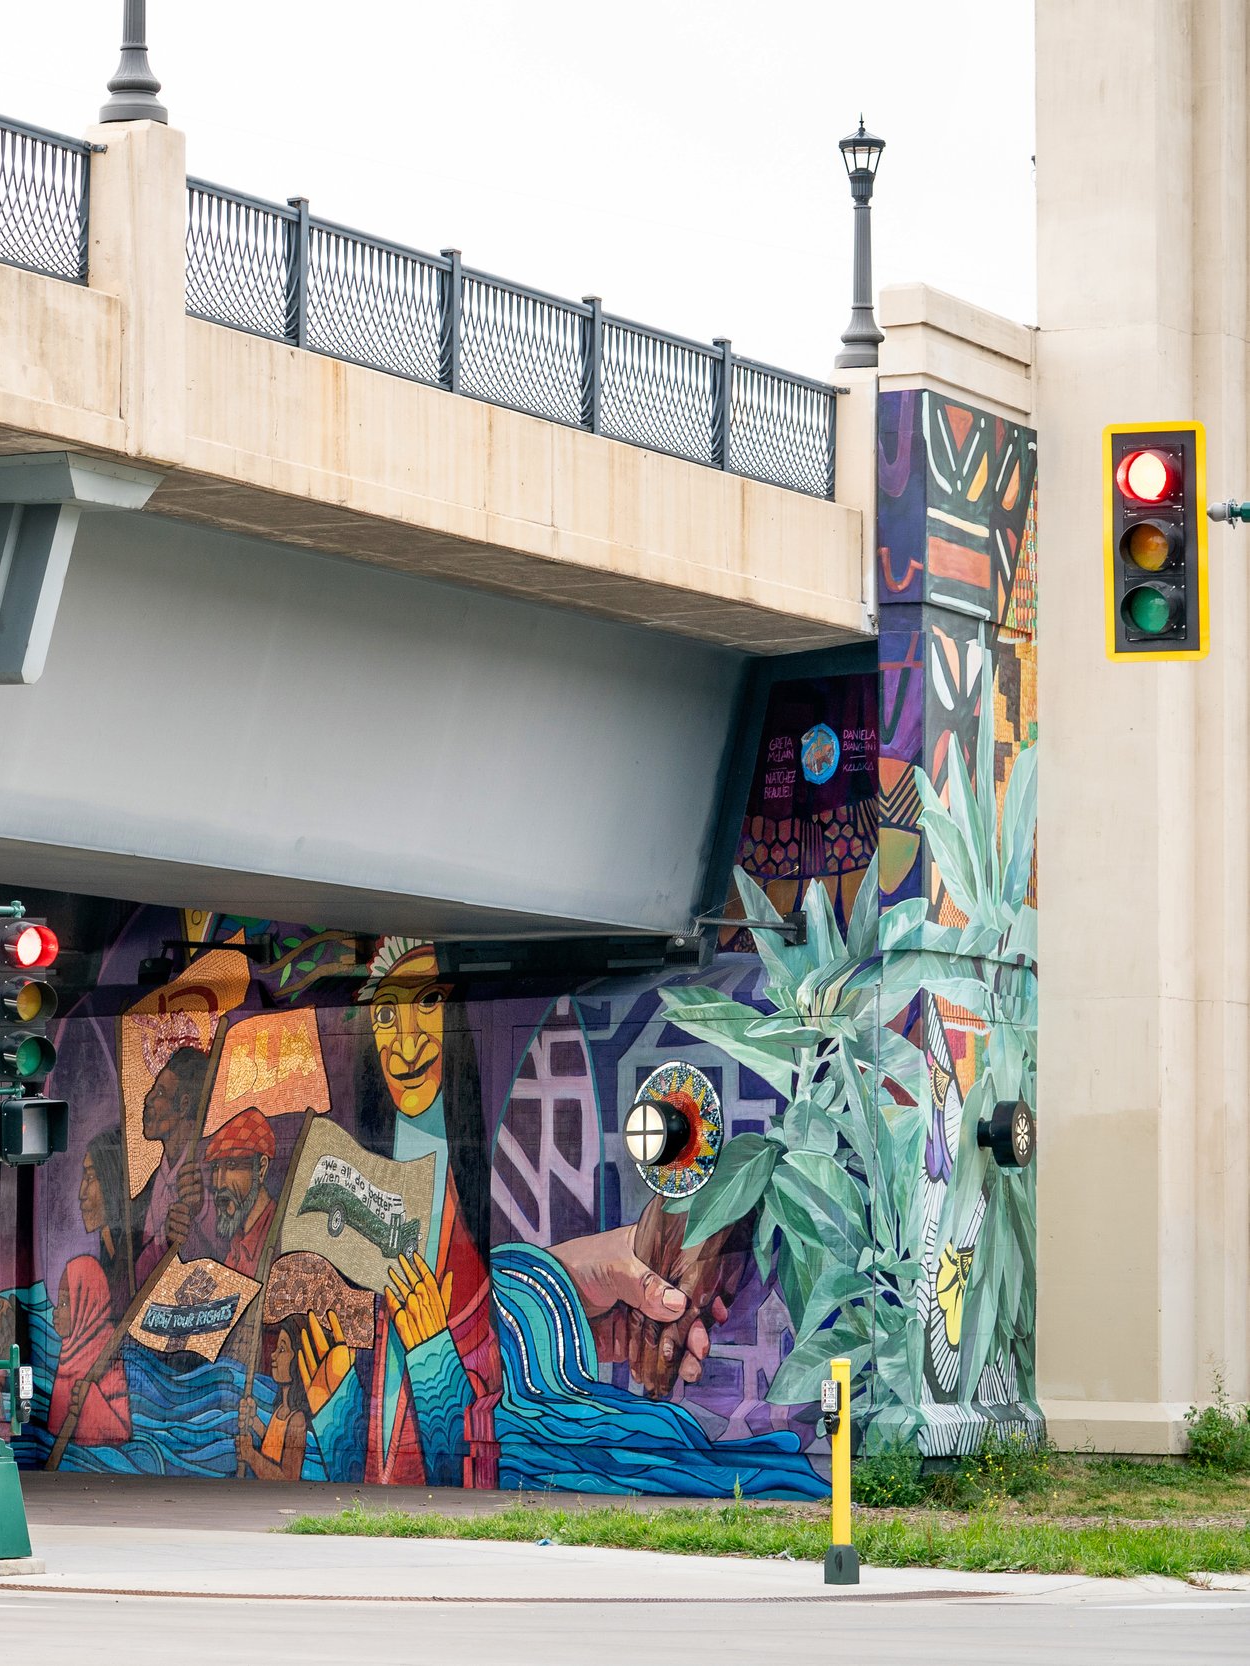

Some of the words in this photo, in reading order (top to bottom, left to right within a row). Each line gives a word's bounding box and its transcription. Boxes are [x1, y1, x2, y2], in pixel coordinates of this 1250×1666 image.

[769, 737, 792, 750] GRETA
[766, 770, 796, 784] NATCHEZ
[224, 1020, 318, 1104] BLM
[314, 1172, 340, 1185] when
[344, 1180, 357, 1193] we
[362, 1194, 372, 1209] all
[375, 1207, 386, 1220] do
[340, 1165, 352, 1180] all
[355, 1174, 366, 1190] do
[368, 1183, 393, 1212] better
[144, 1309, 172, 1330] KNOW
[173, 1312, 195, 1328] YOUR
[195, 1304, 232, 1326] RIGHTS
